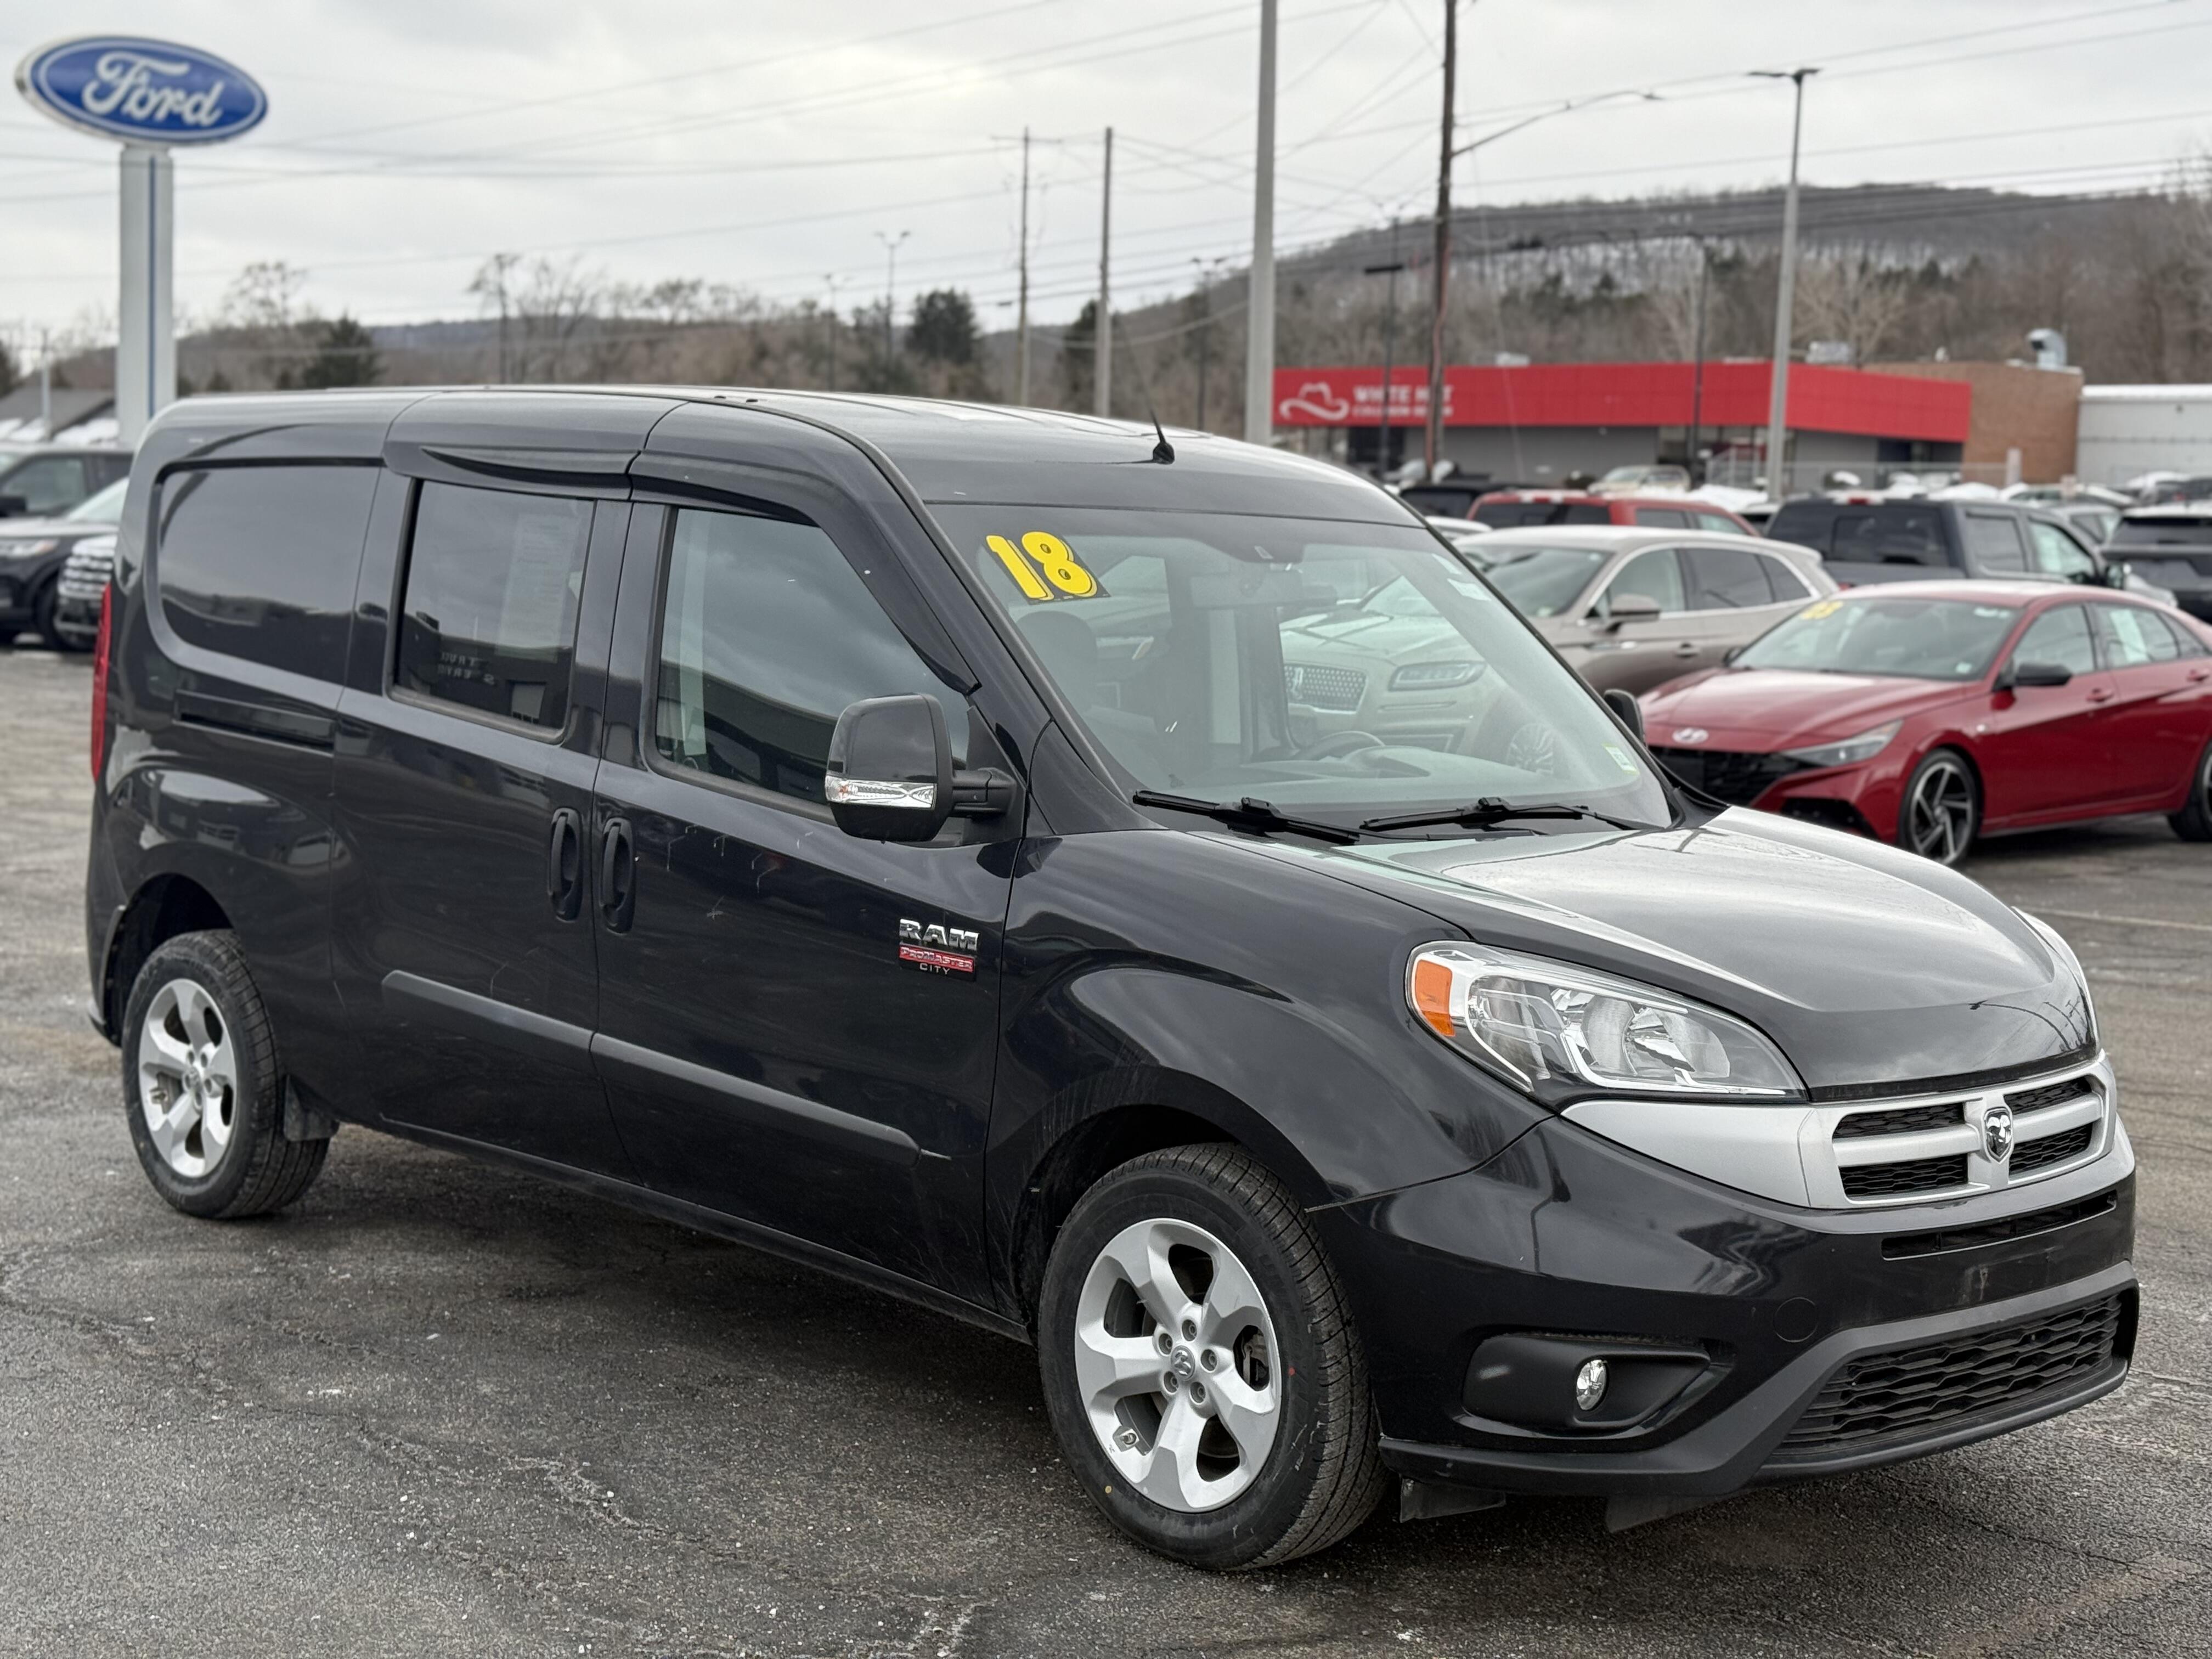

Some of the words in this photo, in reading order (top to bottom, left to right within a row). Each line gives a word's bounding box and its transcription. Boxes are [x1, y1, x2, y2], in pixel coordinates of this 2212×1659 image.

[81, 50, 224, 127] Ford
[986, 531, 1097, 600] 18
[899, 918, 979, 951] RAM
[919, 963, 950, 975] CITY
